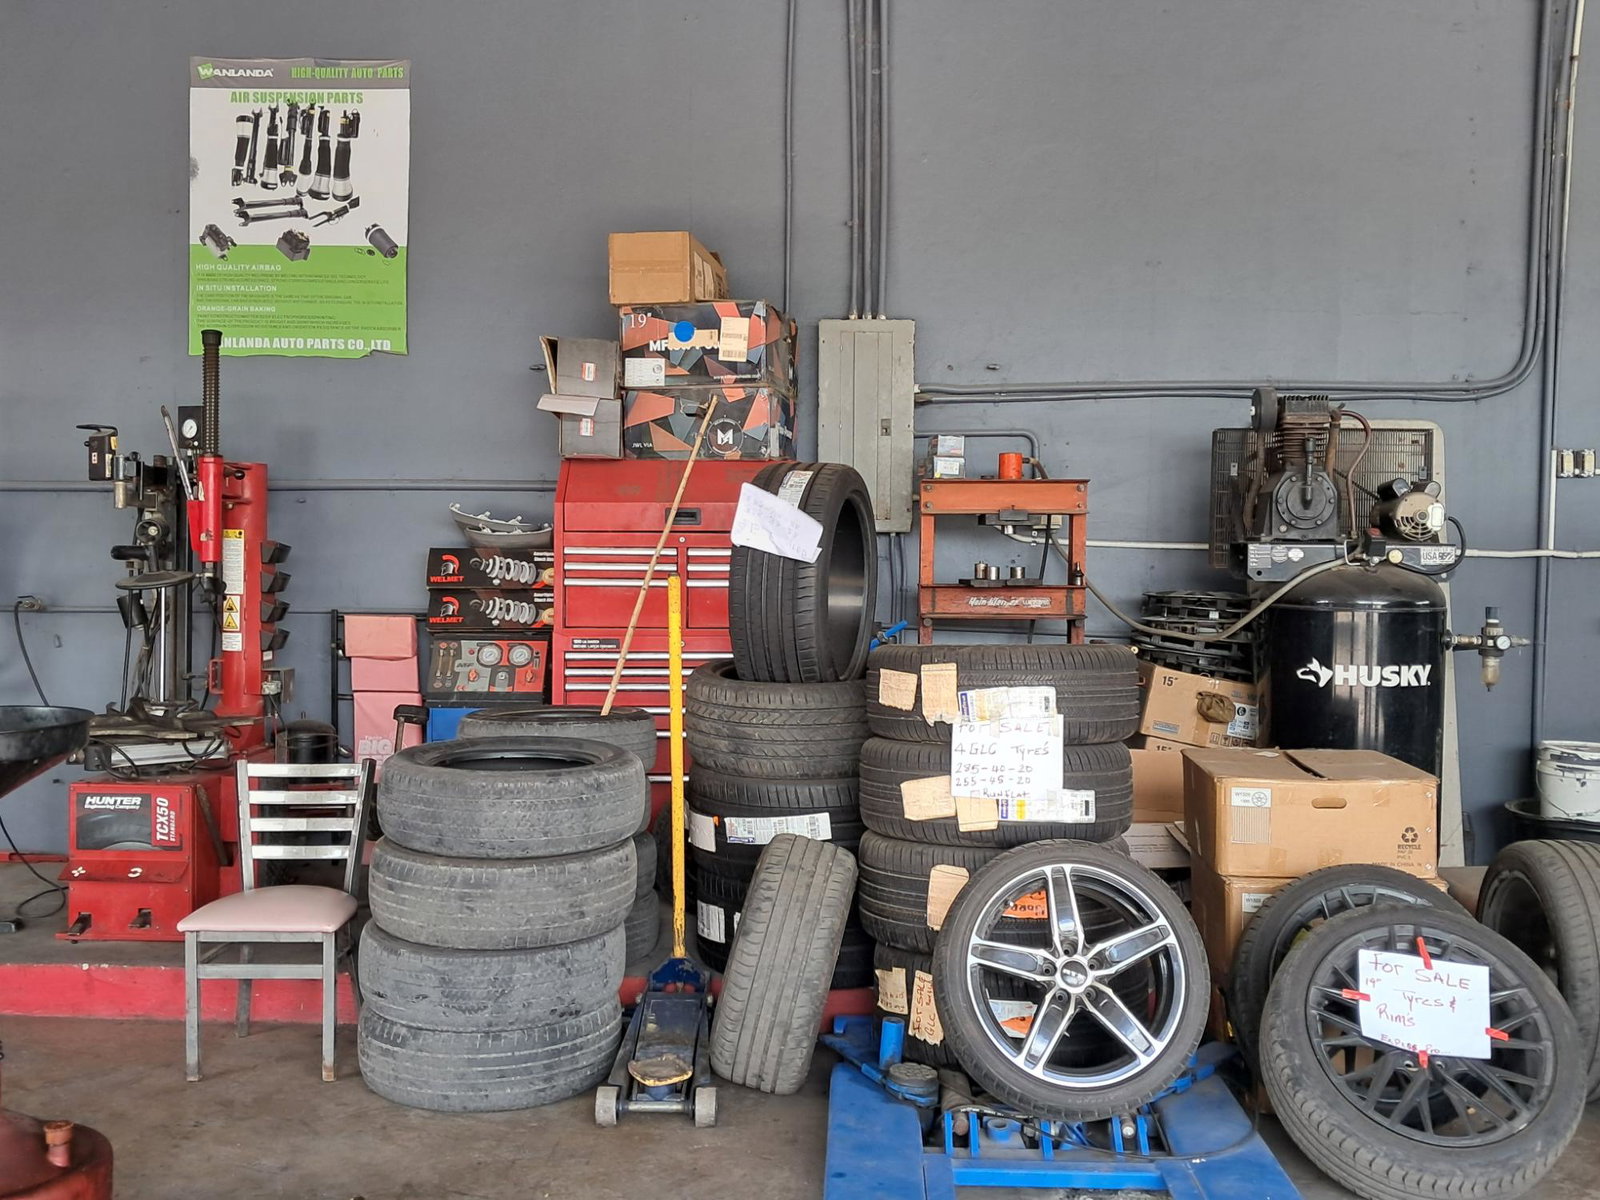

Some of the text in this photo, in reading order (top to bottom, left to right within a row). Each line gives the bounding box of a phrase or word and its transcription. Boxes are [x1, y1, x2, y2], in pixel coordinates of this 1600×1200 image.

[198, 63, 272, 79] WANLANDA
[291, 67, 404, 79] HIGH-QUALITY AUTO PARTS
[231, 92, 364, 104] AIR SUSPENSION PARTS
[196, 263, 215, 271] HIGH
[216, 263, 250, 271] QUALITY
[272, 337, 304, 349] AUTO
[306, 338, 345, 349] PARTS
[1422, 552, 1437, 560] USA
[430, 575, 464, 583] WELMET
[429, 616, 464, 624] WELMET
[1334, 664, 1431, 687] HUSKY
[358, 739, 393, 754] BIG
[954, 742, 966, 755] 4
[84, 796, 141, 805] HUNTER
[156, 797, 169, 841] TCX50
[1415, 968, 1471, 989] SALE
